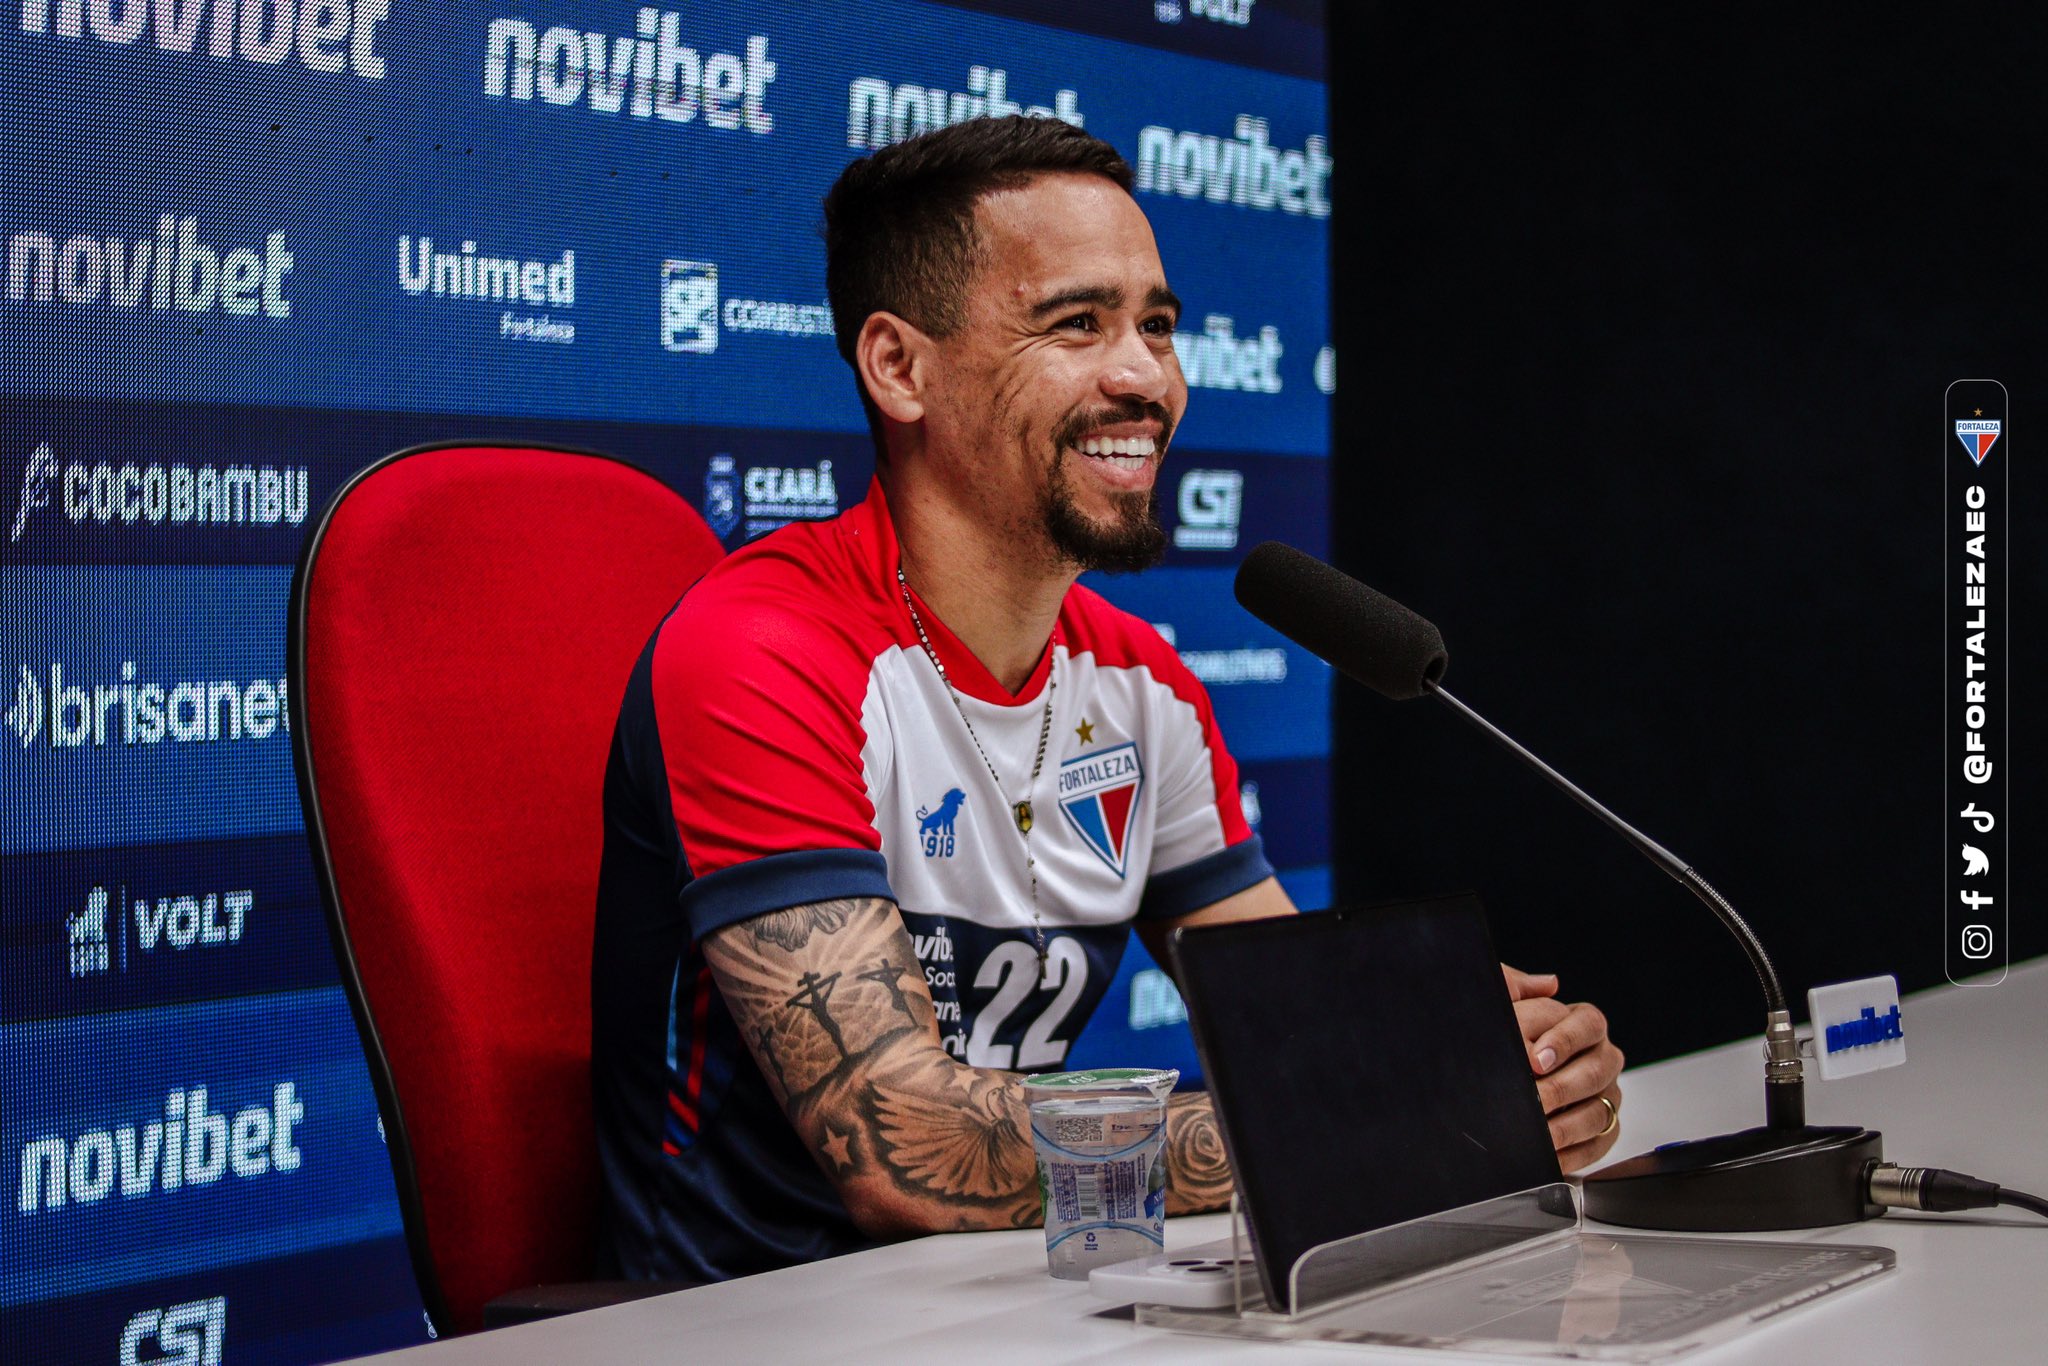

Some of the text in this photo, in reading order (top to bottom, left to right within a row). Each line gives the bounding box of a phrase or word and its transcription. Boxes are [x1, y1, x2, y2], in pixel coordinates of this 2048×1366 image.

[484, 7, 776, 134] novibet
[847, 65, 1086, 150] novibt
[1137, 114, 1334, 217] novibet
[8, 213, 294, 318] novibet
[399, 235, 574, 305] Unimed
[1172, 313, 1284, 394] vibet
[64, 461, 309, 526] COCOBAMBU
[744, 460, 838, 504] CEARÁ
[51, 660, 290, 748] brisane
[1059, 755, 1136, 793] FORTALEZA
[135, 889, 253, 950] VOLT
[966, 936, 1089, 1069] 22
[17, 1081, 304, 1216] novibet
